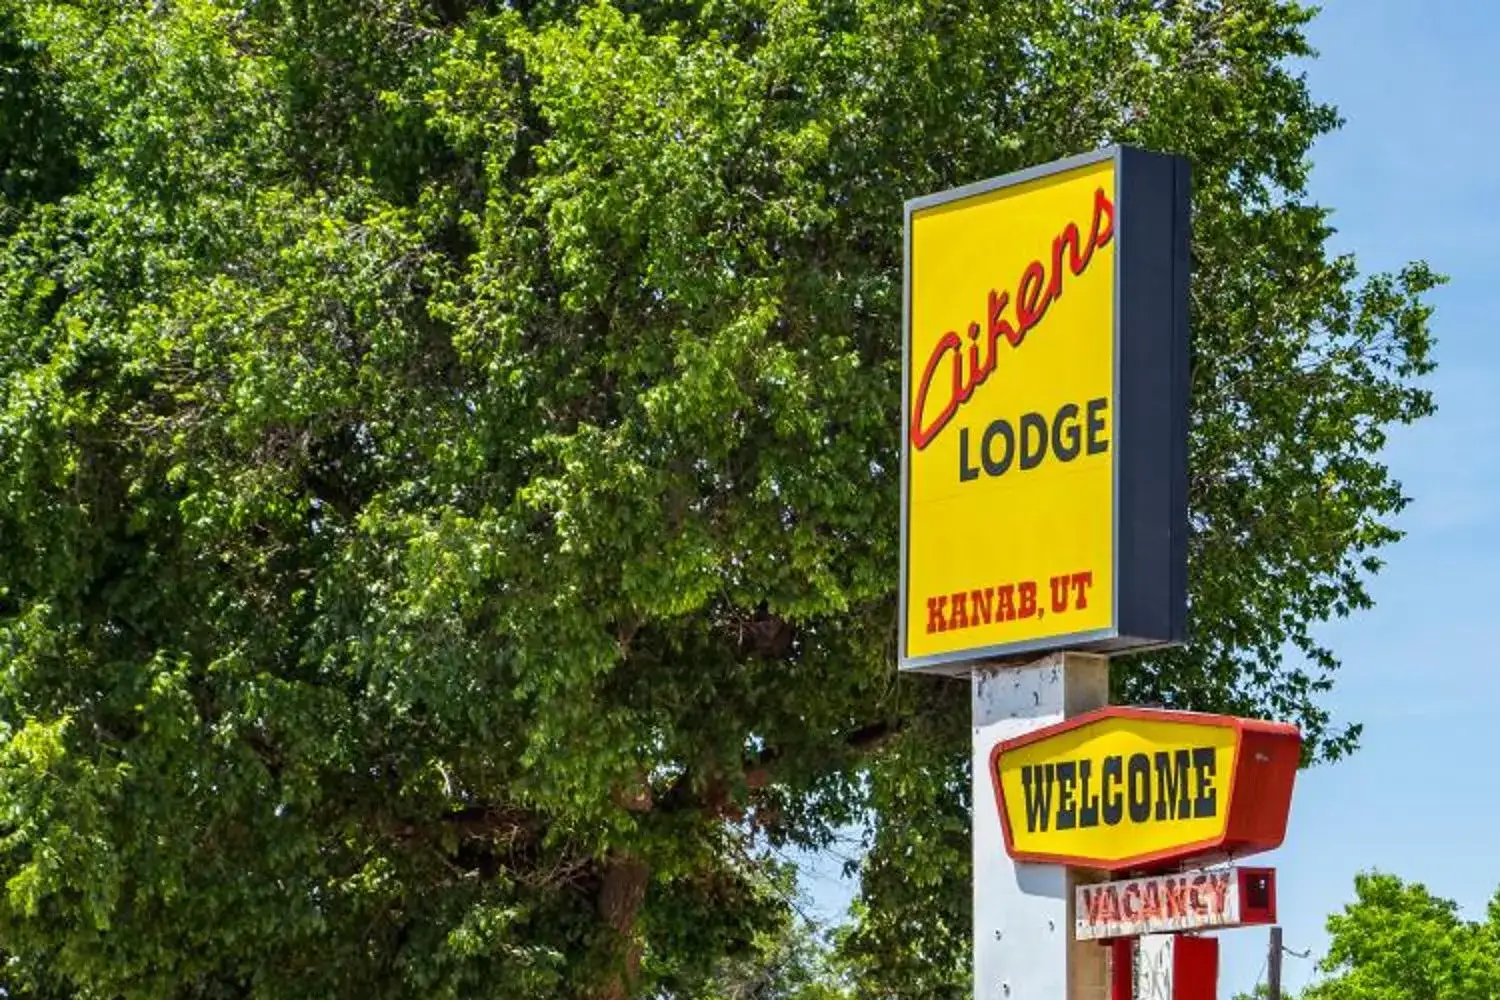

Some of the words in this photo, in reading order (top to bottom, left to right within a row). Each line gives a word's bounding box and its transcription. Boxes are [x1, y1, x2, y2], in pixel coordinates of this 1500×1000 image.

[912, 188, 1115, 450] Aikens
[959, 398, 1110, 482] LODGE
[926, 586, 1045, 634] KANAB,
[1049, 571, 1093, 612] UT
[1021, 747, 1217, 834] WELCOME
[1083, 872, 1231, 926] VACANCY
